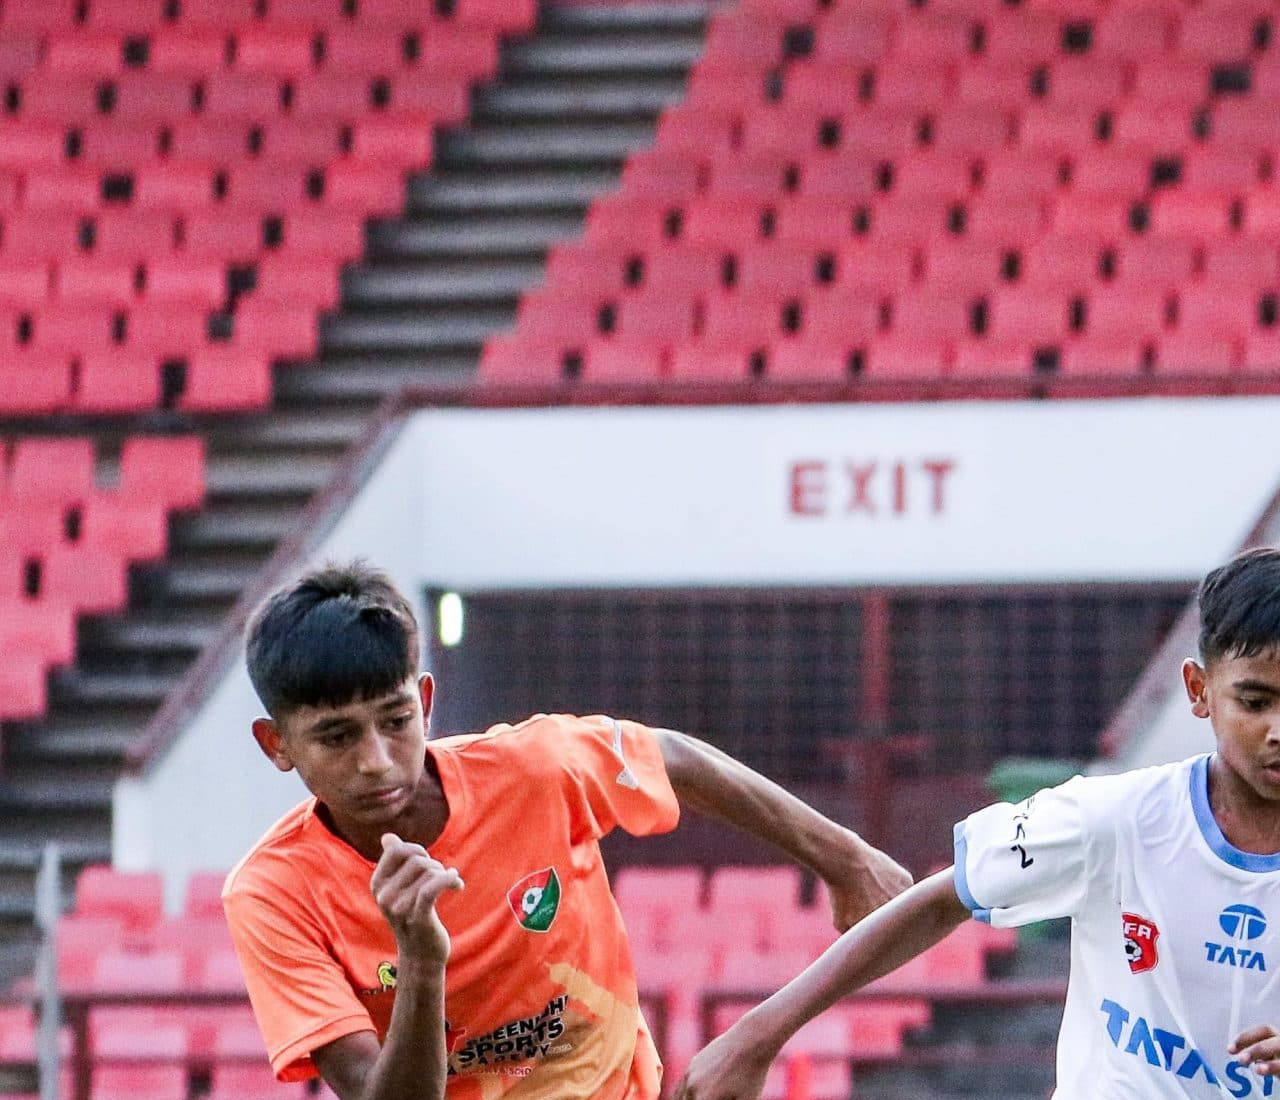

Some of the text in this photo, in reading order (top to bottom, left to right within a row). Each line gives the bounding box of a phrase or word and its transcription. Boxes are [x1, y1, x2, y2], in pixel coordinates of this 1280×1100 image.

[789, 459, 957, 514] EXIT
[1124, 922, 1152, 940] FA
[1204, 942, 1266, 972] TATA
[1101, 998, 1222, 1089] TATA
